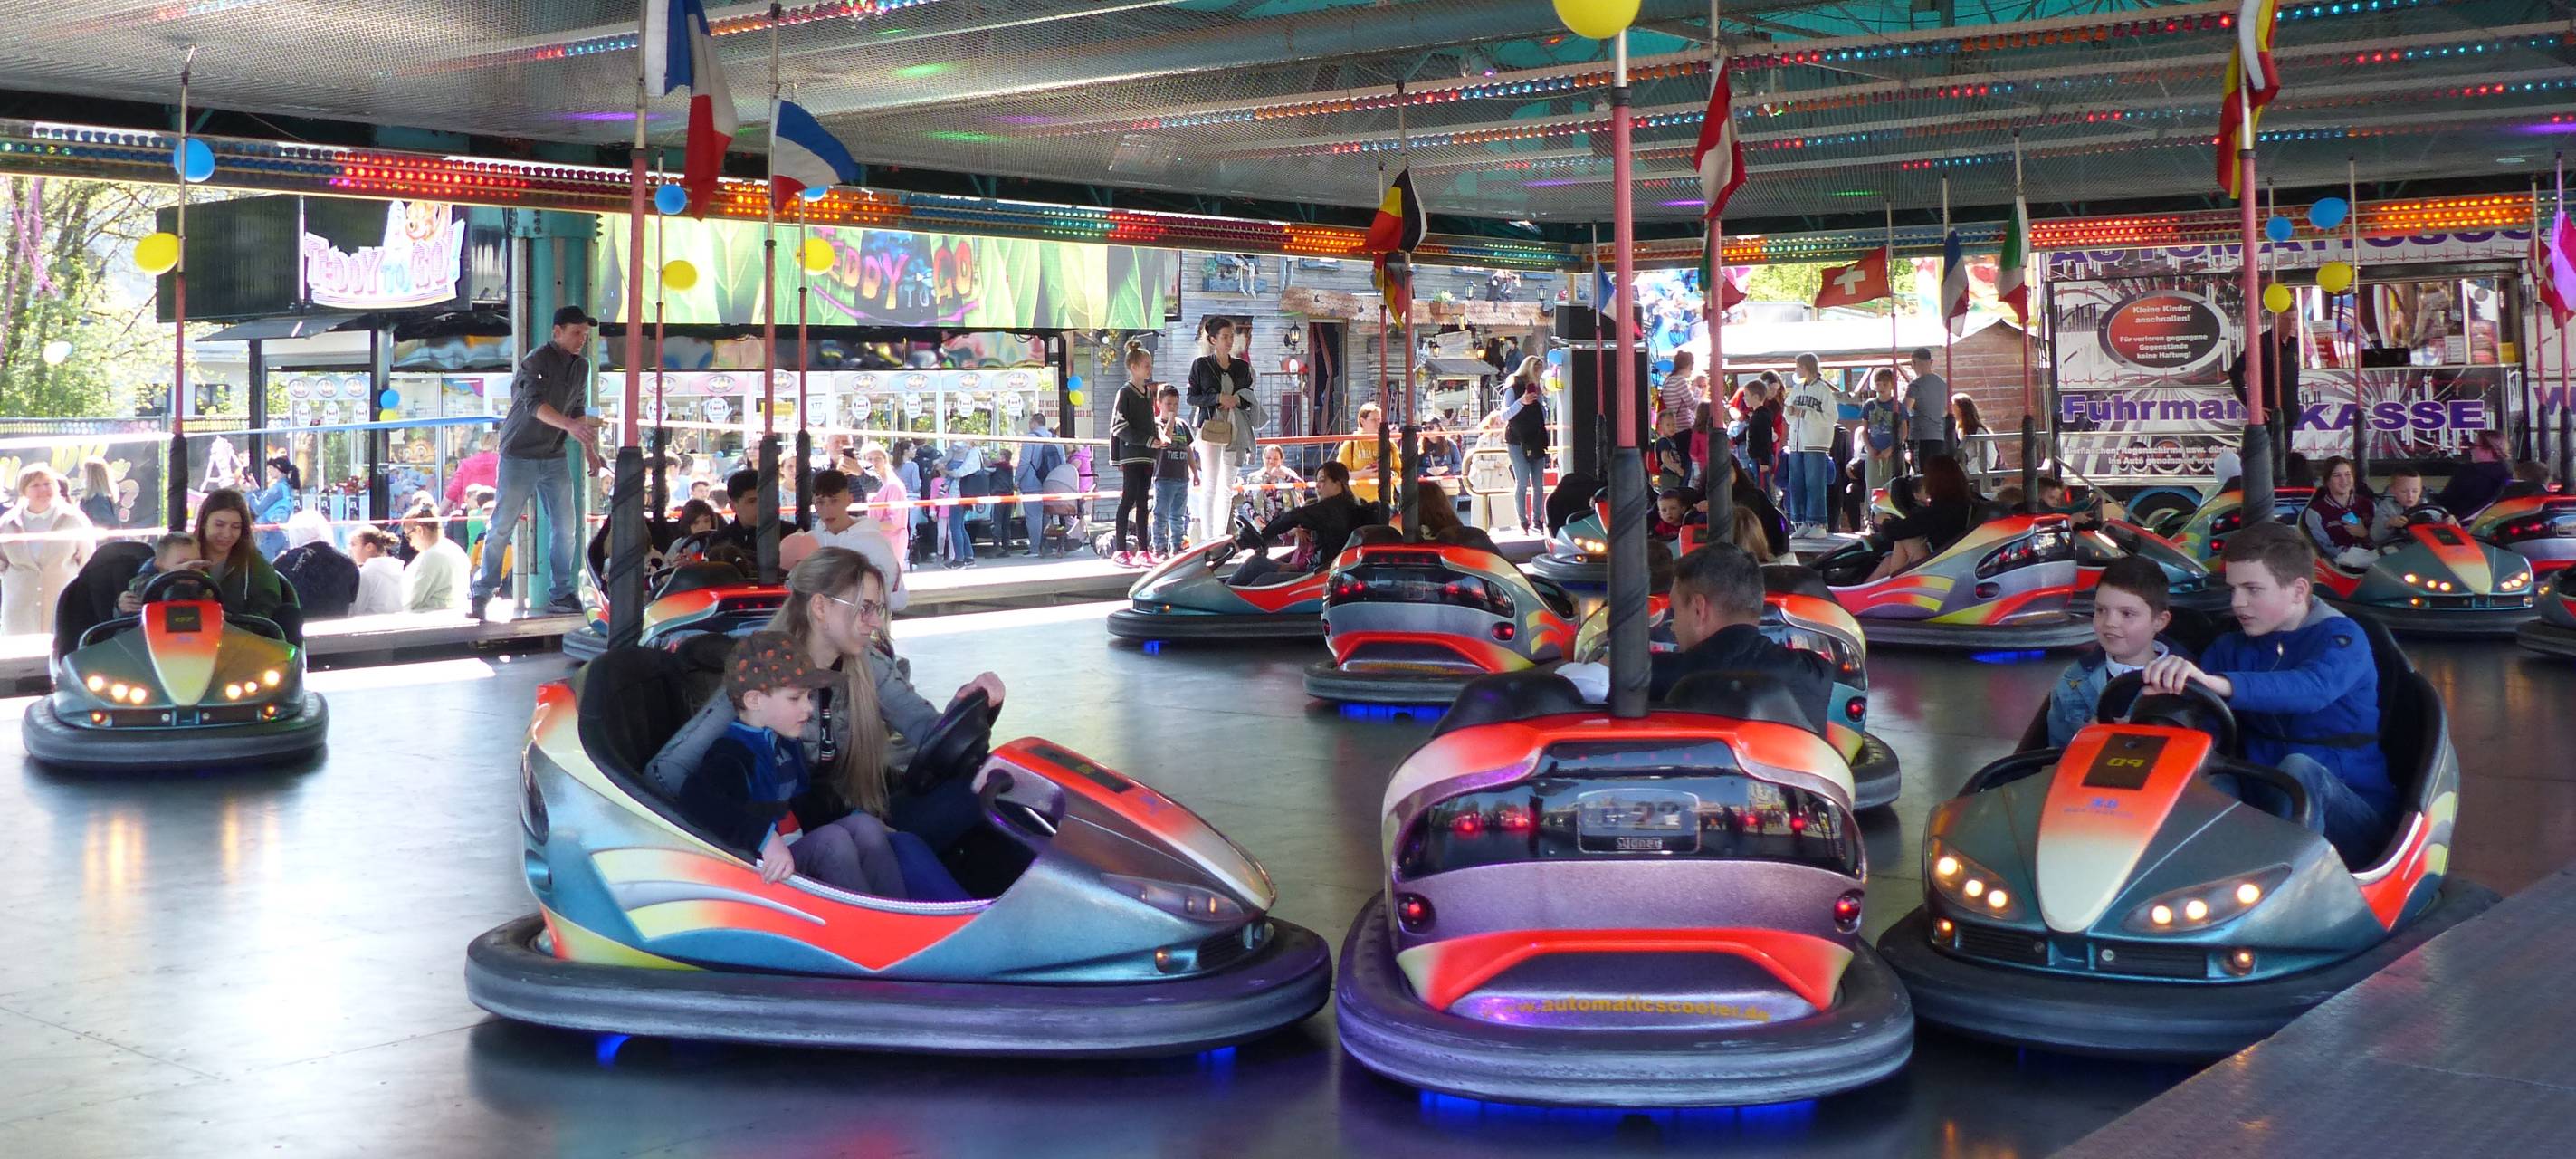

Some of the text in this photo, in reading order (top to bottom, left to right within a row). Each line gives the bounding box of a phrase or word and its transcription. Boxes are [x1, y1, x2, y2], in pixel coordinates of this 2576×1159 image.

[2162, 304, 2192, 312] Kinder
[2135, 315, 2190, 323] anschnallen!
[2166, 334, 2209, 342] gegangene
[2139, 343, 2189, 351] Gegenstände
[2159, 351, 2191, 359] Haftung!
[2061, 393, 2249, 422] Fuhrman
[2294, 400, 2486, 431] KASSE
[2123, 456, 2144, 465] Auto
